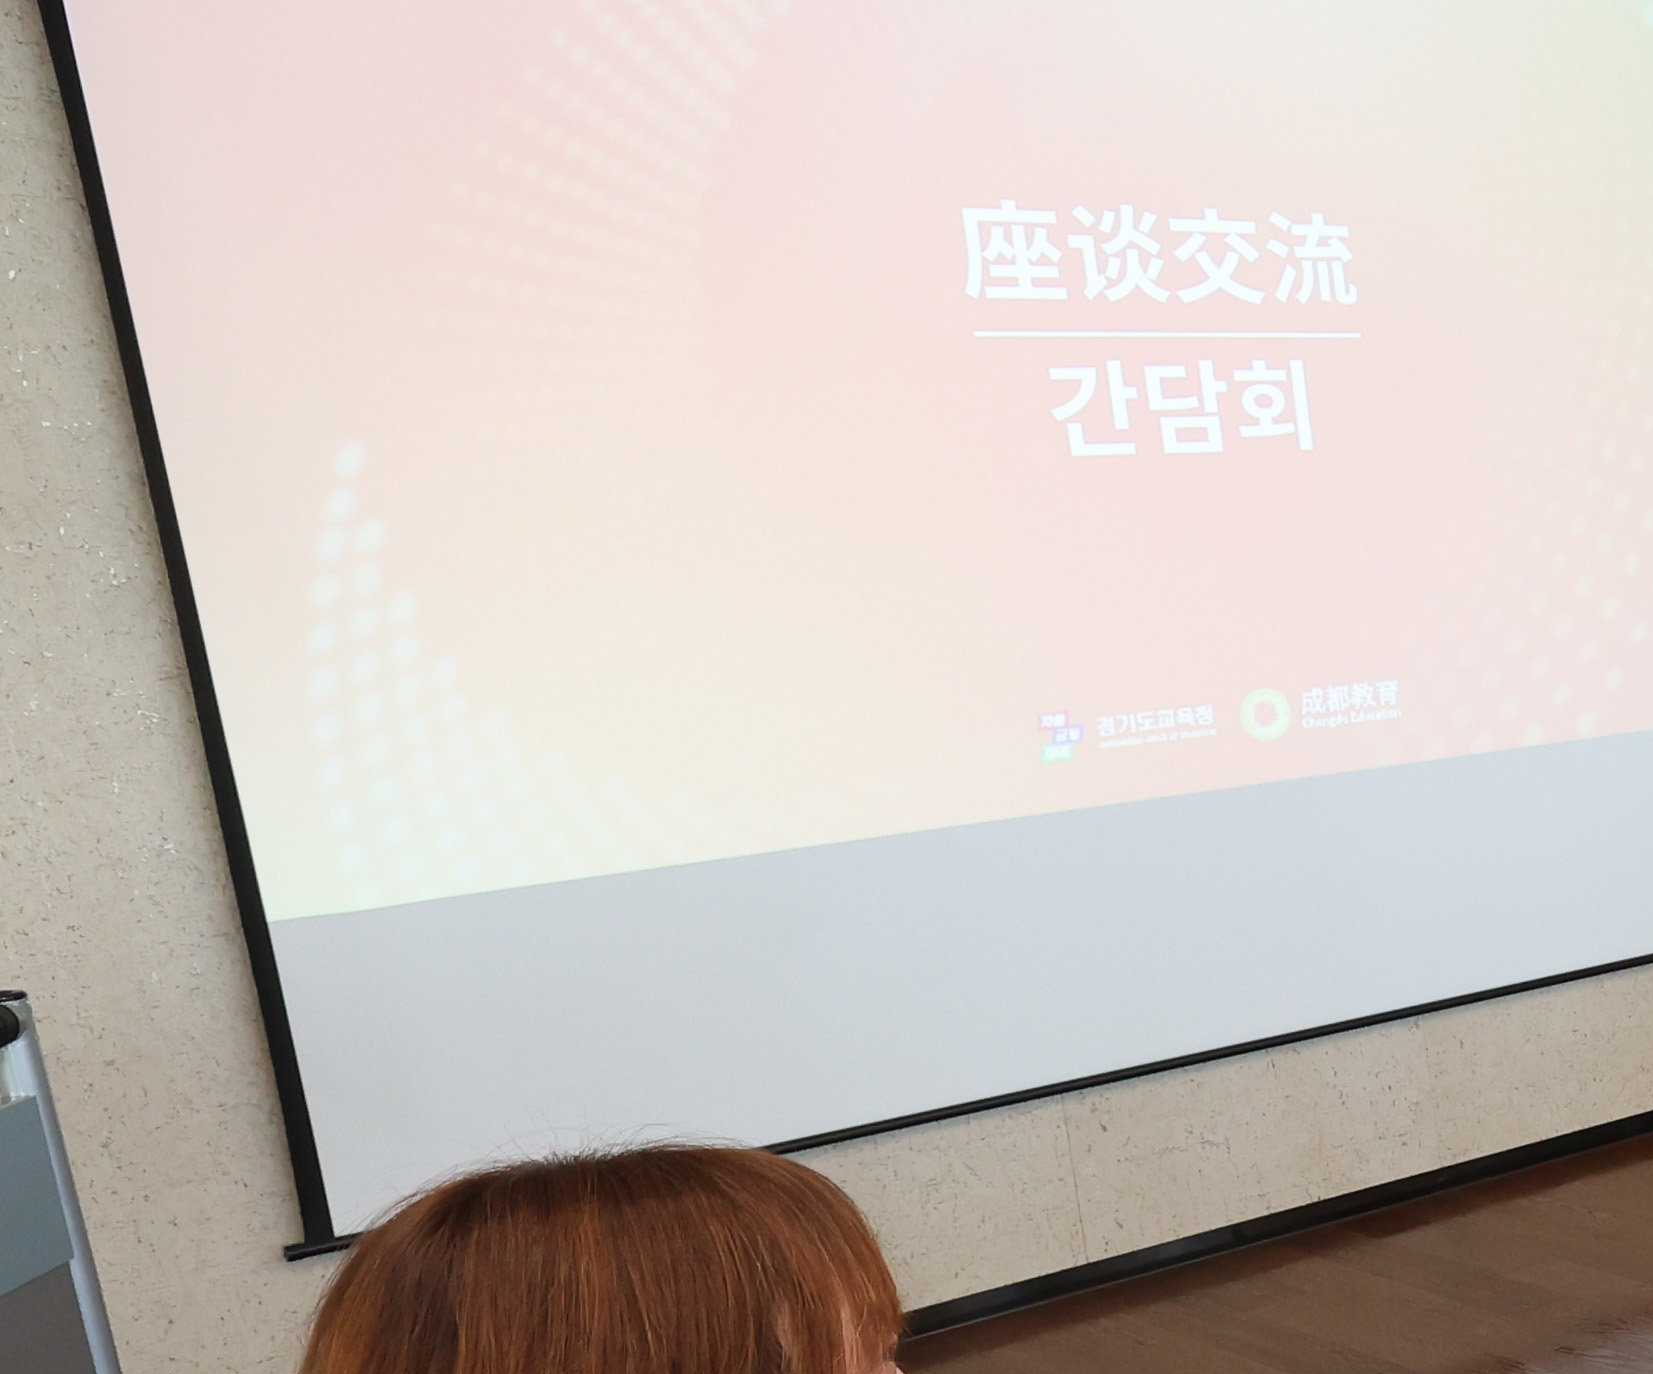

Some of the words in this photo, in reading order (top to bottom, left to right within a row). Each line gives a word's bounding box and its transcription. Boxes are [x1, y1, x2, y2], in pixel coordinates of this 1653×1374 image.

[961, 199, 1359, 305] 座谈交流
[1048, 359, 1315, 457] 간담회
[1096, 704, 1215, 738] 경기도교육청
[1301, 679, 1399, 715] 成都教育
